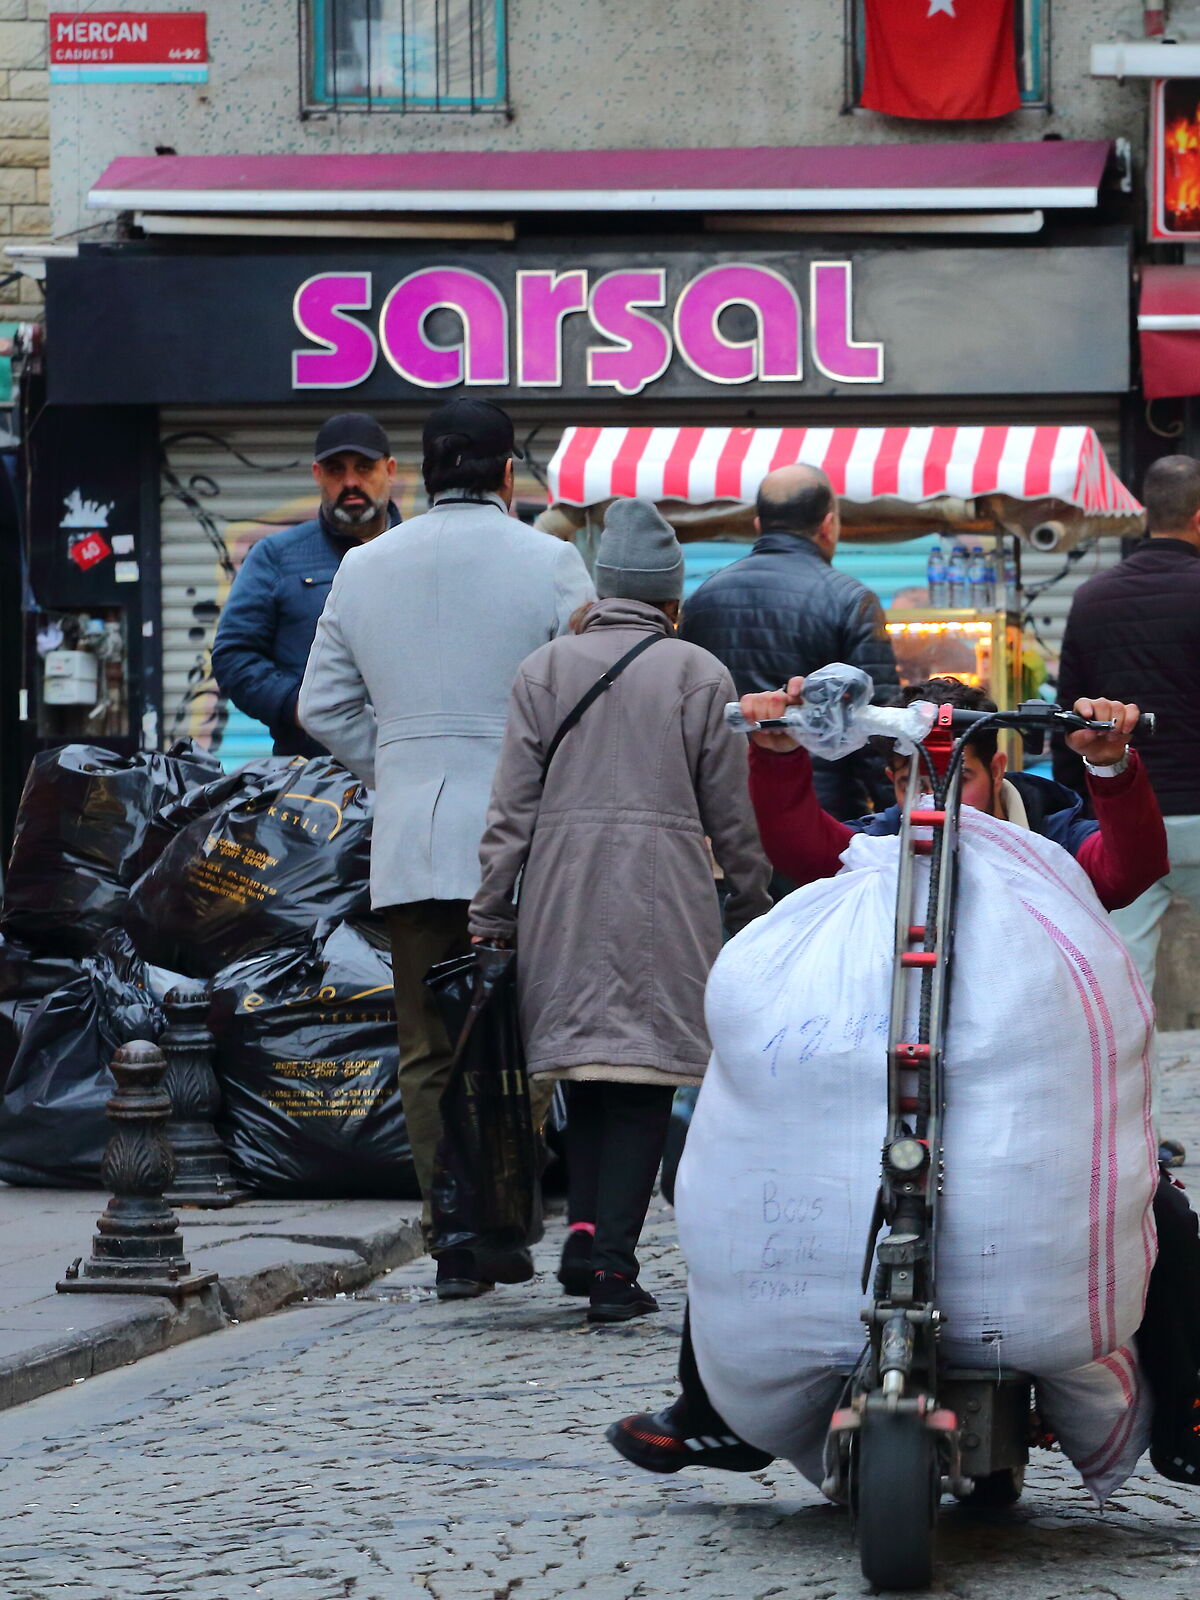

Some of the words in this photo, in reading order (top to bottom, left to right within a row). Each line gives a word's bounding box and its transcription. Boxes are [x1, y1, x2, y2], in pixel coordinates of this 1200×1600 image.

[57, 22, 147, 43] MERCAN
[56, 47, 114, 60] CADDESİ
[292, 261, 884, 395] sarşal
